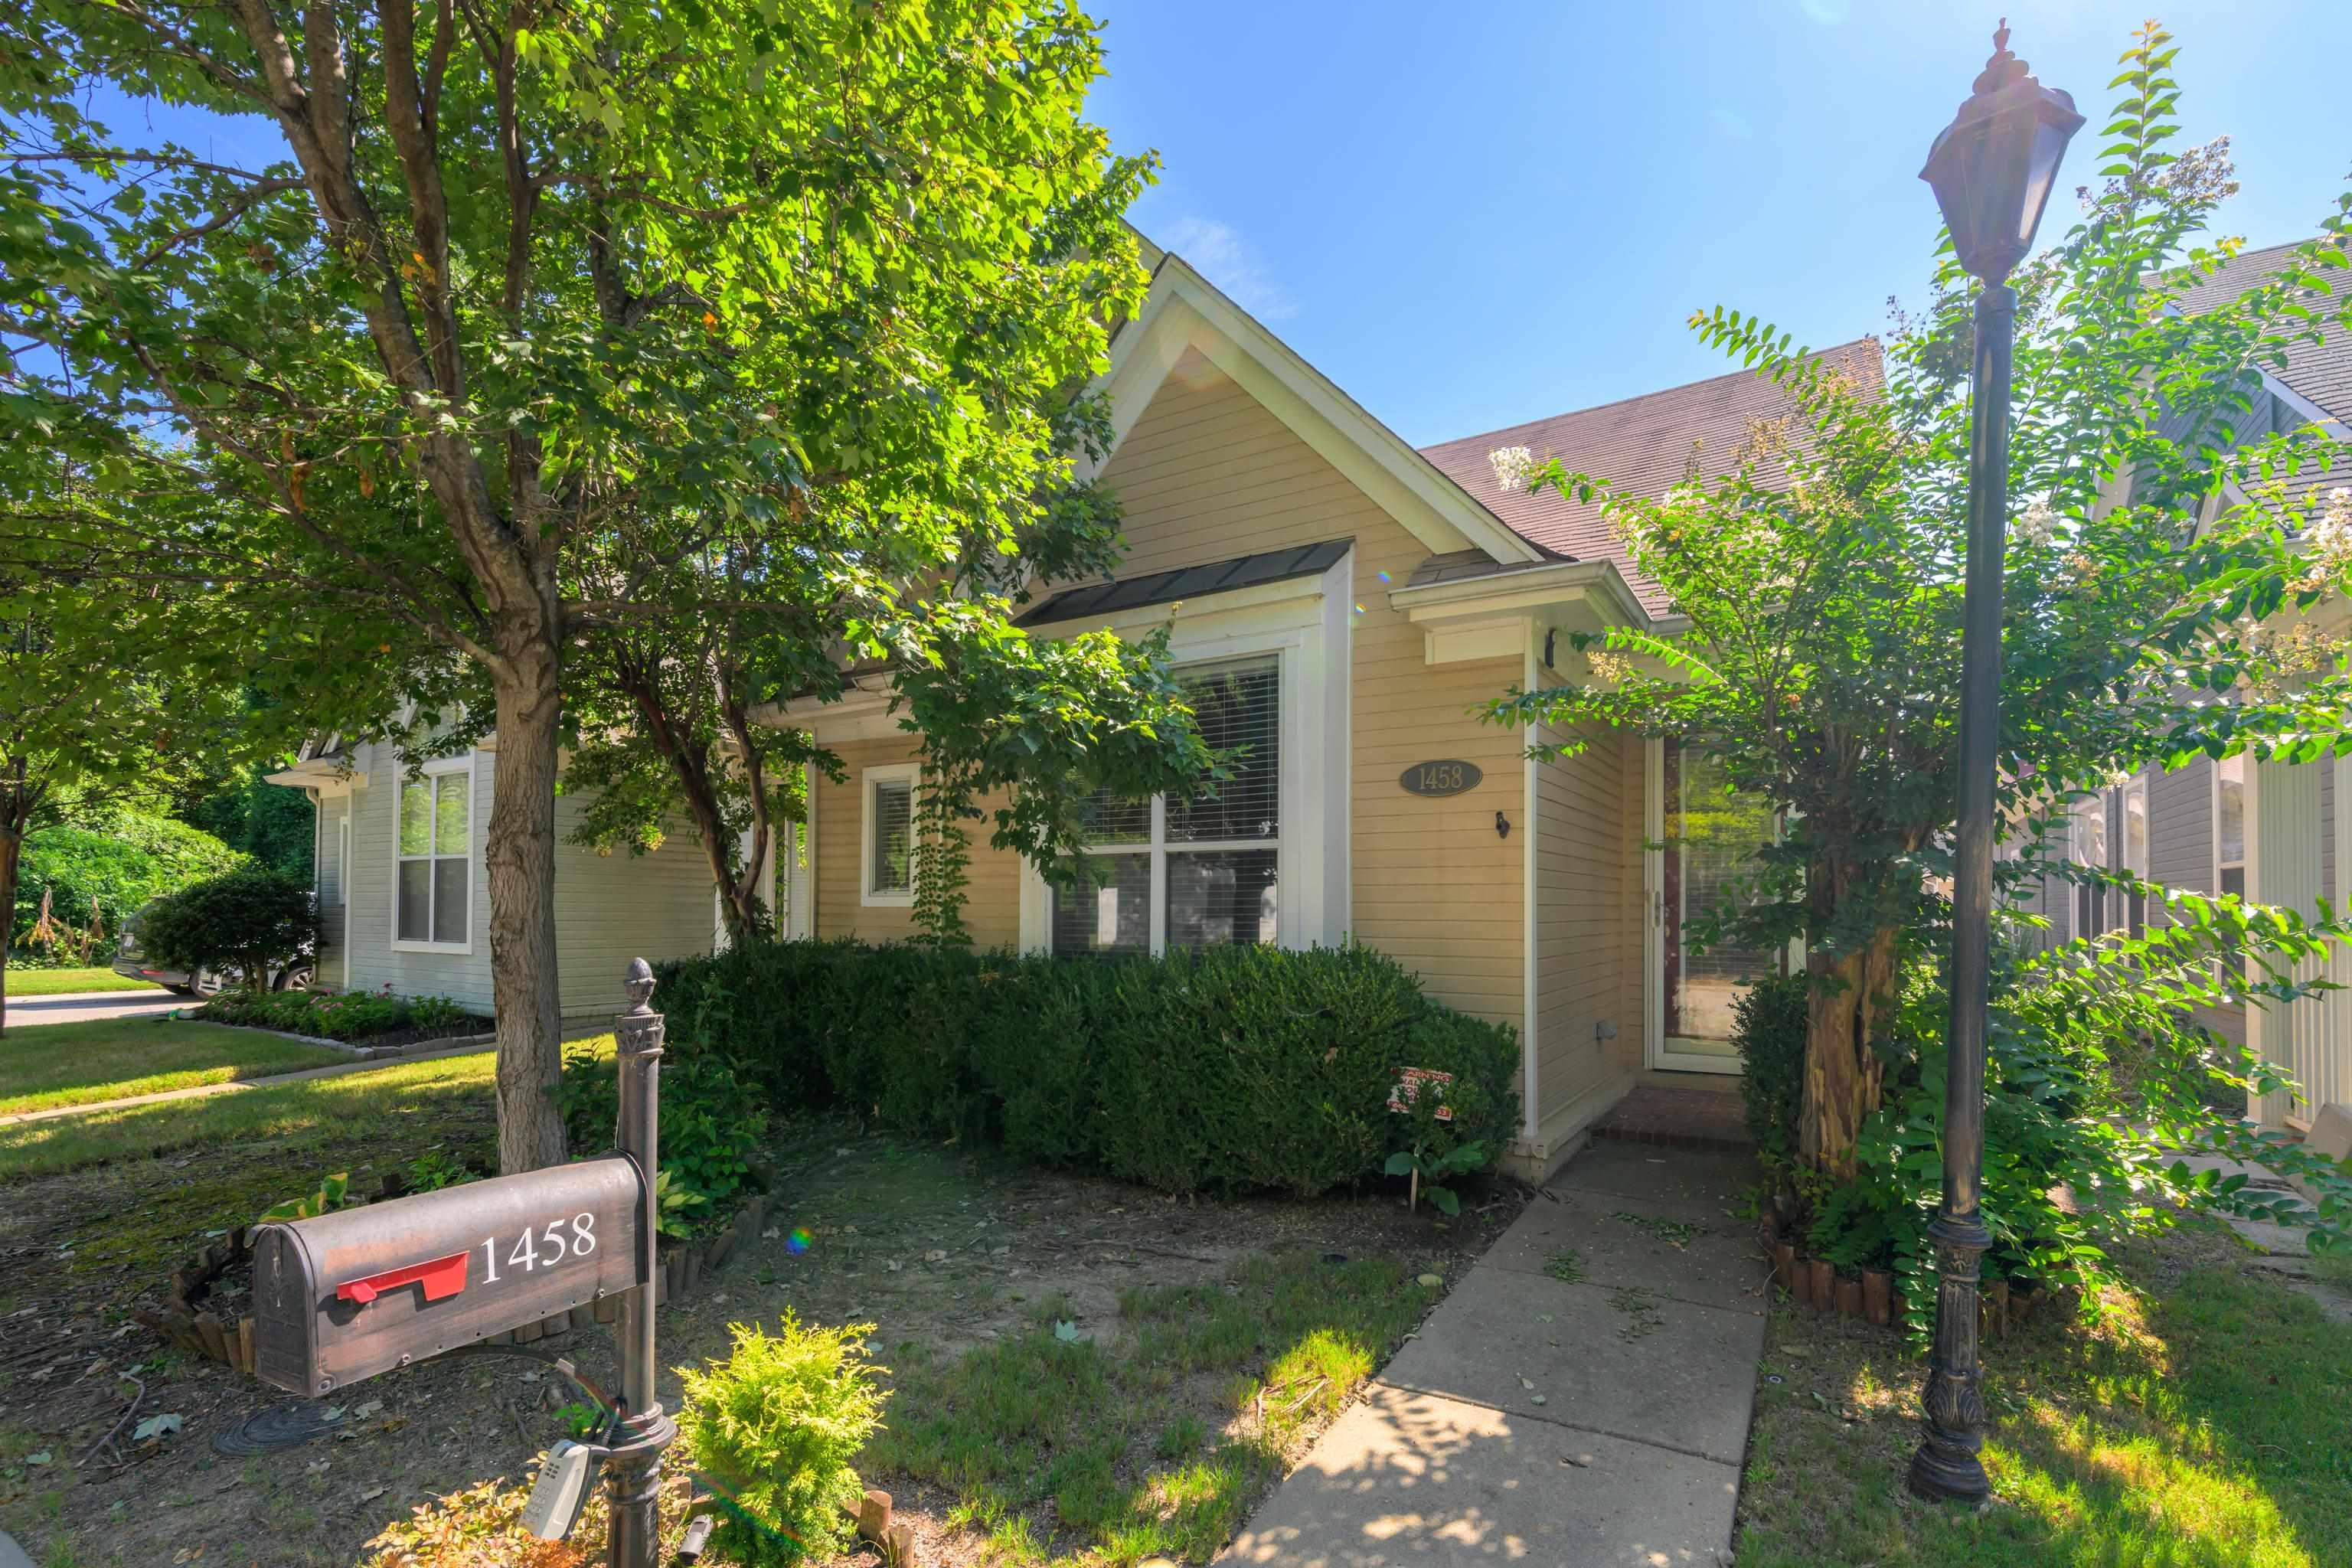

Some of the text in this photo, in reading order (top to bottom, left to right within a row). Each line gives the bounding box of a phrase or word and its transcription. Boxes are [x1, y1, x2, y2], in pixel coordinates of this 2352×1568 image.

[1419, 766, 1463, 790] 1458
[1403, 1070, 1448, 1082] ARNNG
[481, 1212, 596, 1285] 1458
